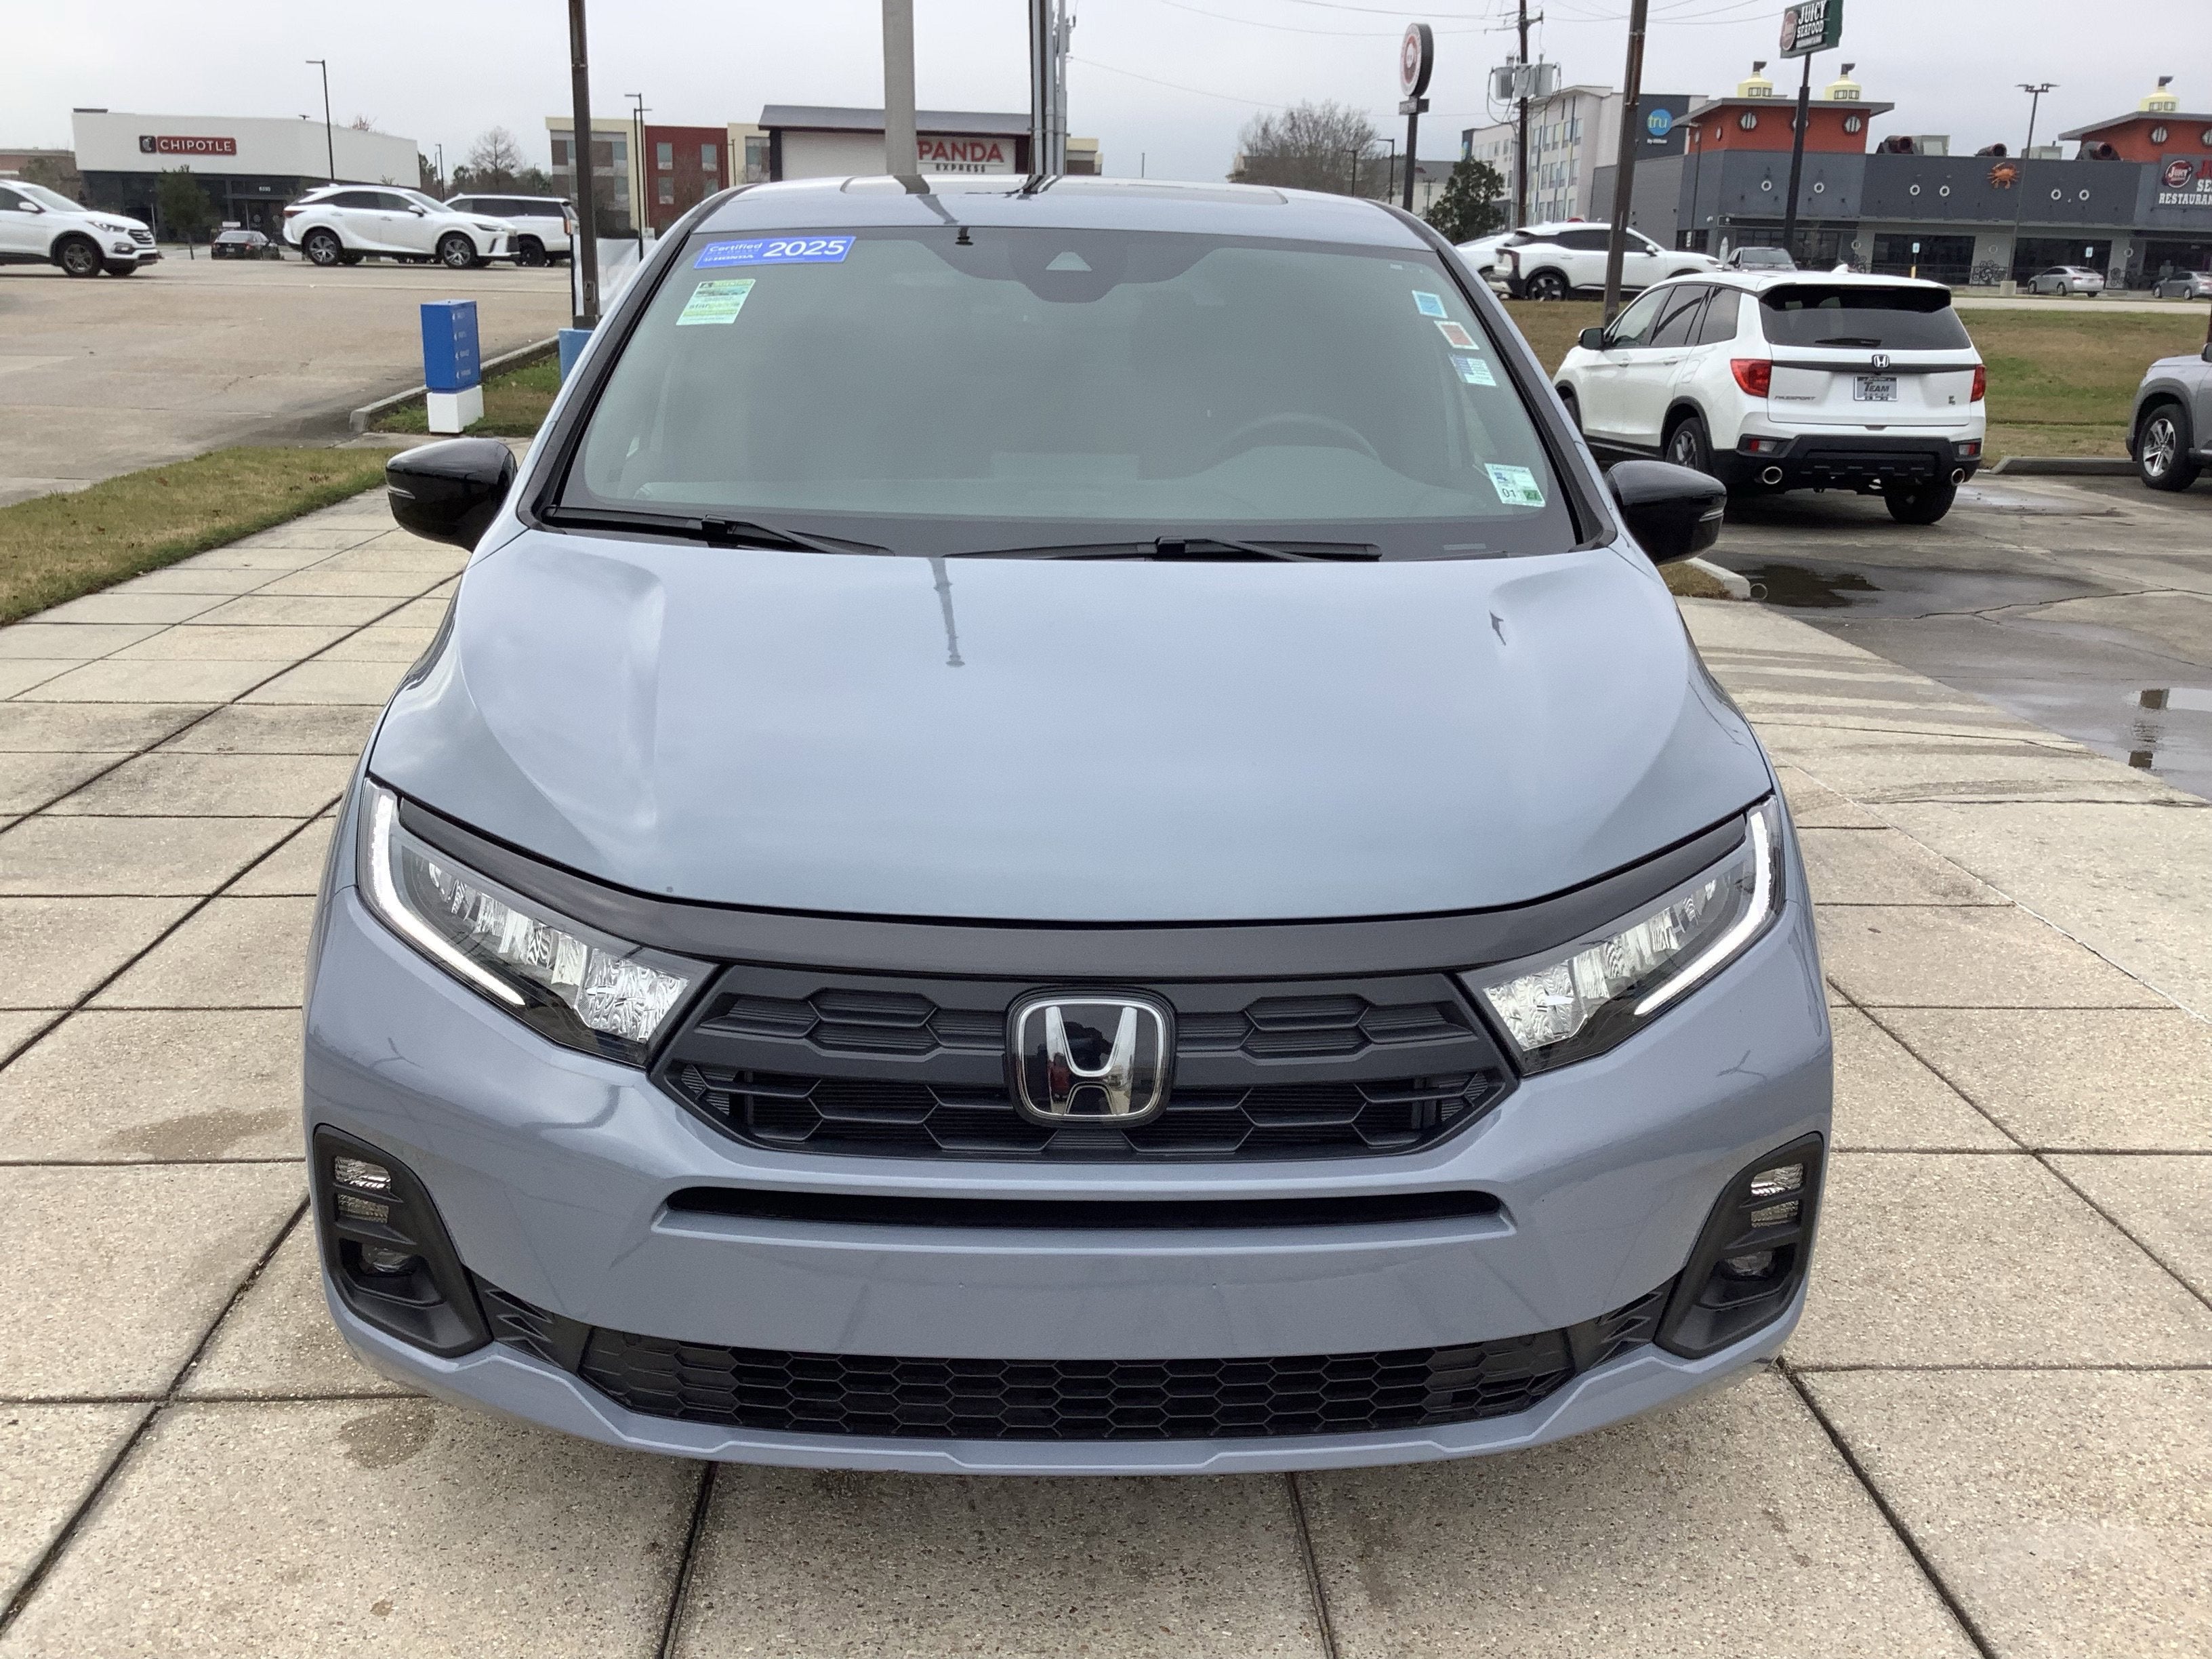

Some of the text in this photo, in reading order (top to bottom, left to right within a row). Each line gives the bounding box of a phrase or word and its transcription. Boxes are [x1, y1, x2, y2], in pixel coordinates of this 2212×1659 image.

[1798, 0, 1827, 24] JUICY
[1797, 20, 1824, 39] SEAFOOD
[1648, 115, 1668, 129] tru
[160, 139, 232, 152] CHIPOTLE
[917, 140, 1004, 163] PANDA
[936, 163, 986, 172] EXPRESS
[710, 243, 763, 251] Certified
[762, 240, 847, 257] 2025
[1864, 382, 1890, 392] TEAM
[1502, 488, 1517, 498] 01
